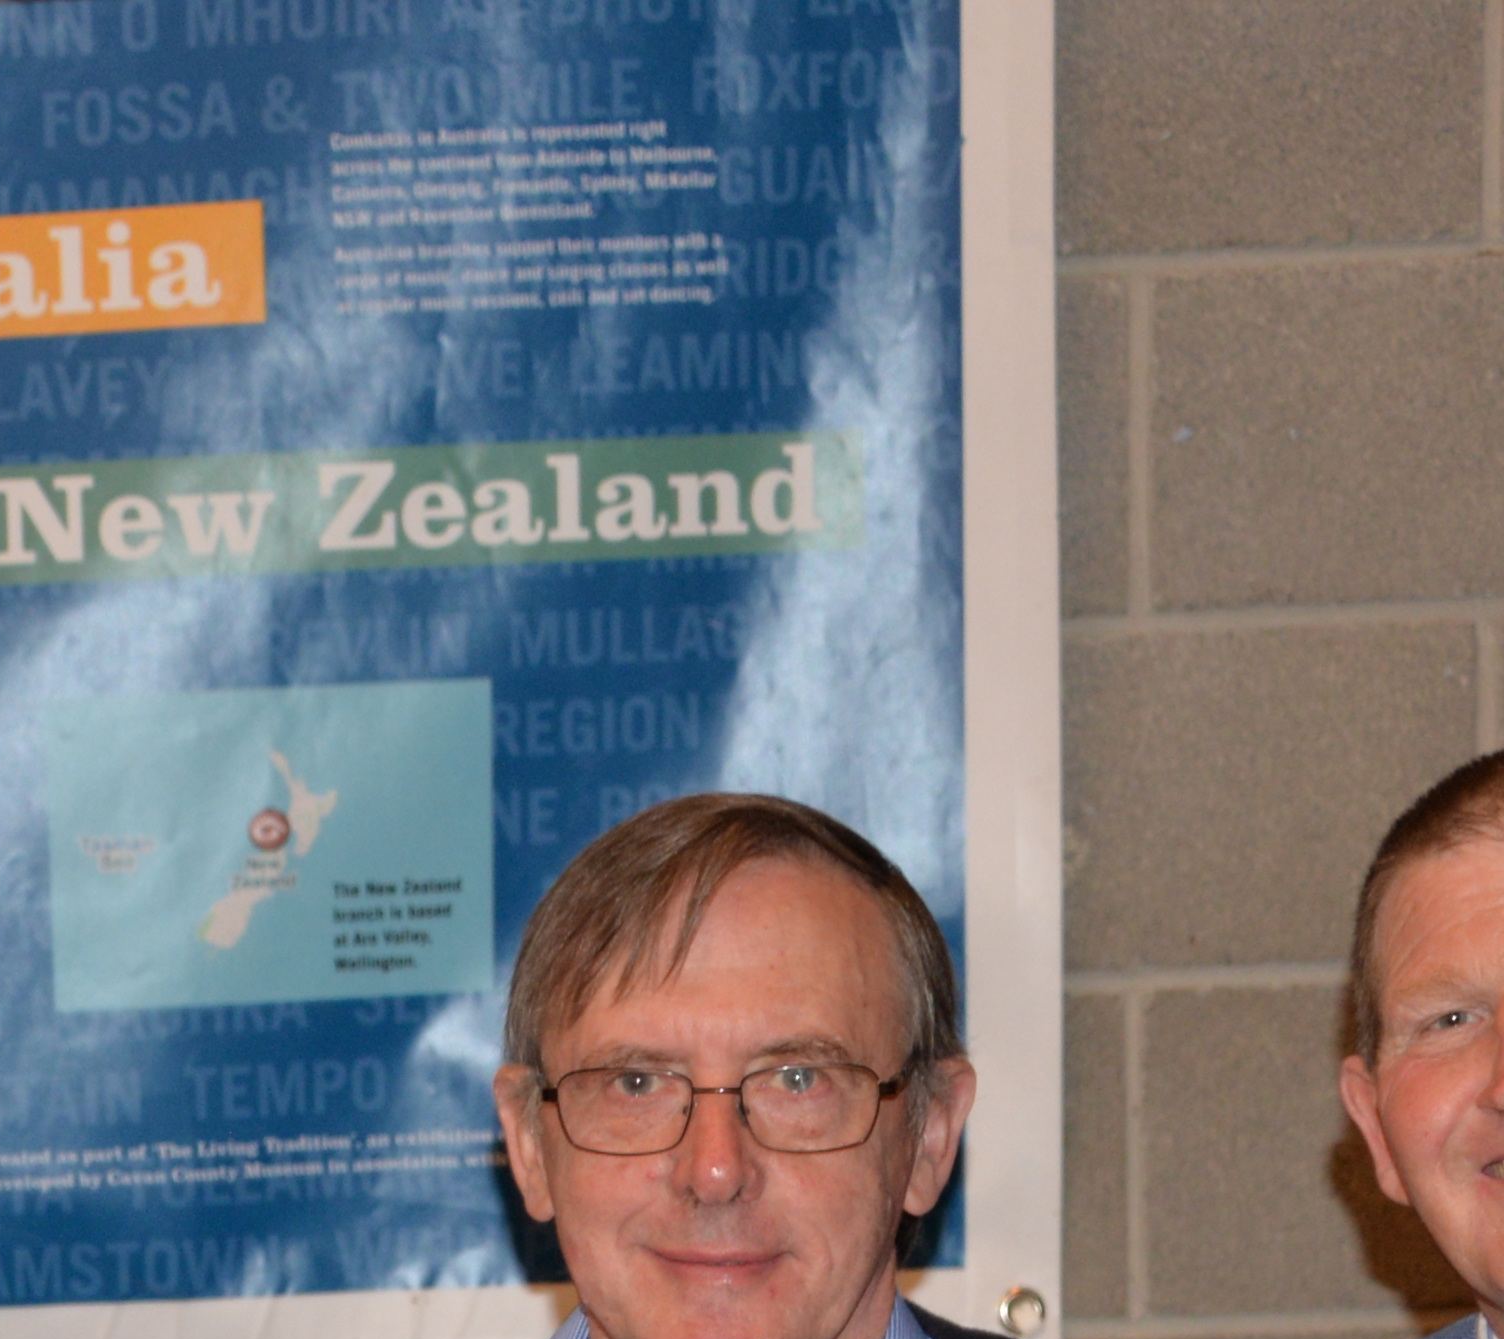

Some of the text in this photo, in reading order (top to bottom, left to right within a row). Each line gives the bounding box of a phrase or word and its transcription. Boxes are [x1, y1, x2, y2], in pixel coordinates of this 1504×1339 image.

[42, 80, 237, 148] FOSSA
[438, 120, 667, 146] Australia represented right
[317, 443, 824, 552] Zealand
[333, 877, 462, 899] The New Zealand
[333, 902, 452, 924] branch based
[334, 932, 349, 949] at
[83, 1144, 125, 1169] part
[126, 1142, 148, 1163] of
[196, 1137, 259, 1164] Living
[394, 1128, 495, 1150] exhibition
[78, 1168, 102, 1192] by
[171, 1163, 240, 1188] County
[243, 1158, 323, 1181] Museum
[328, 1156, 349, 1176] in
